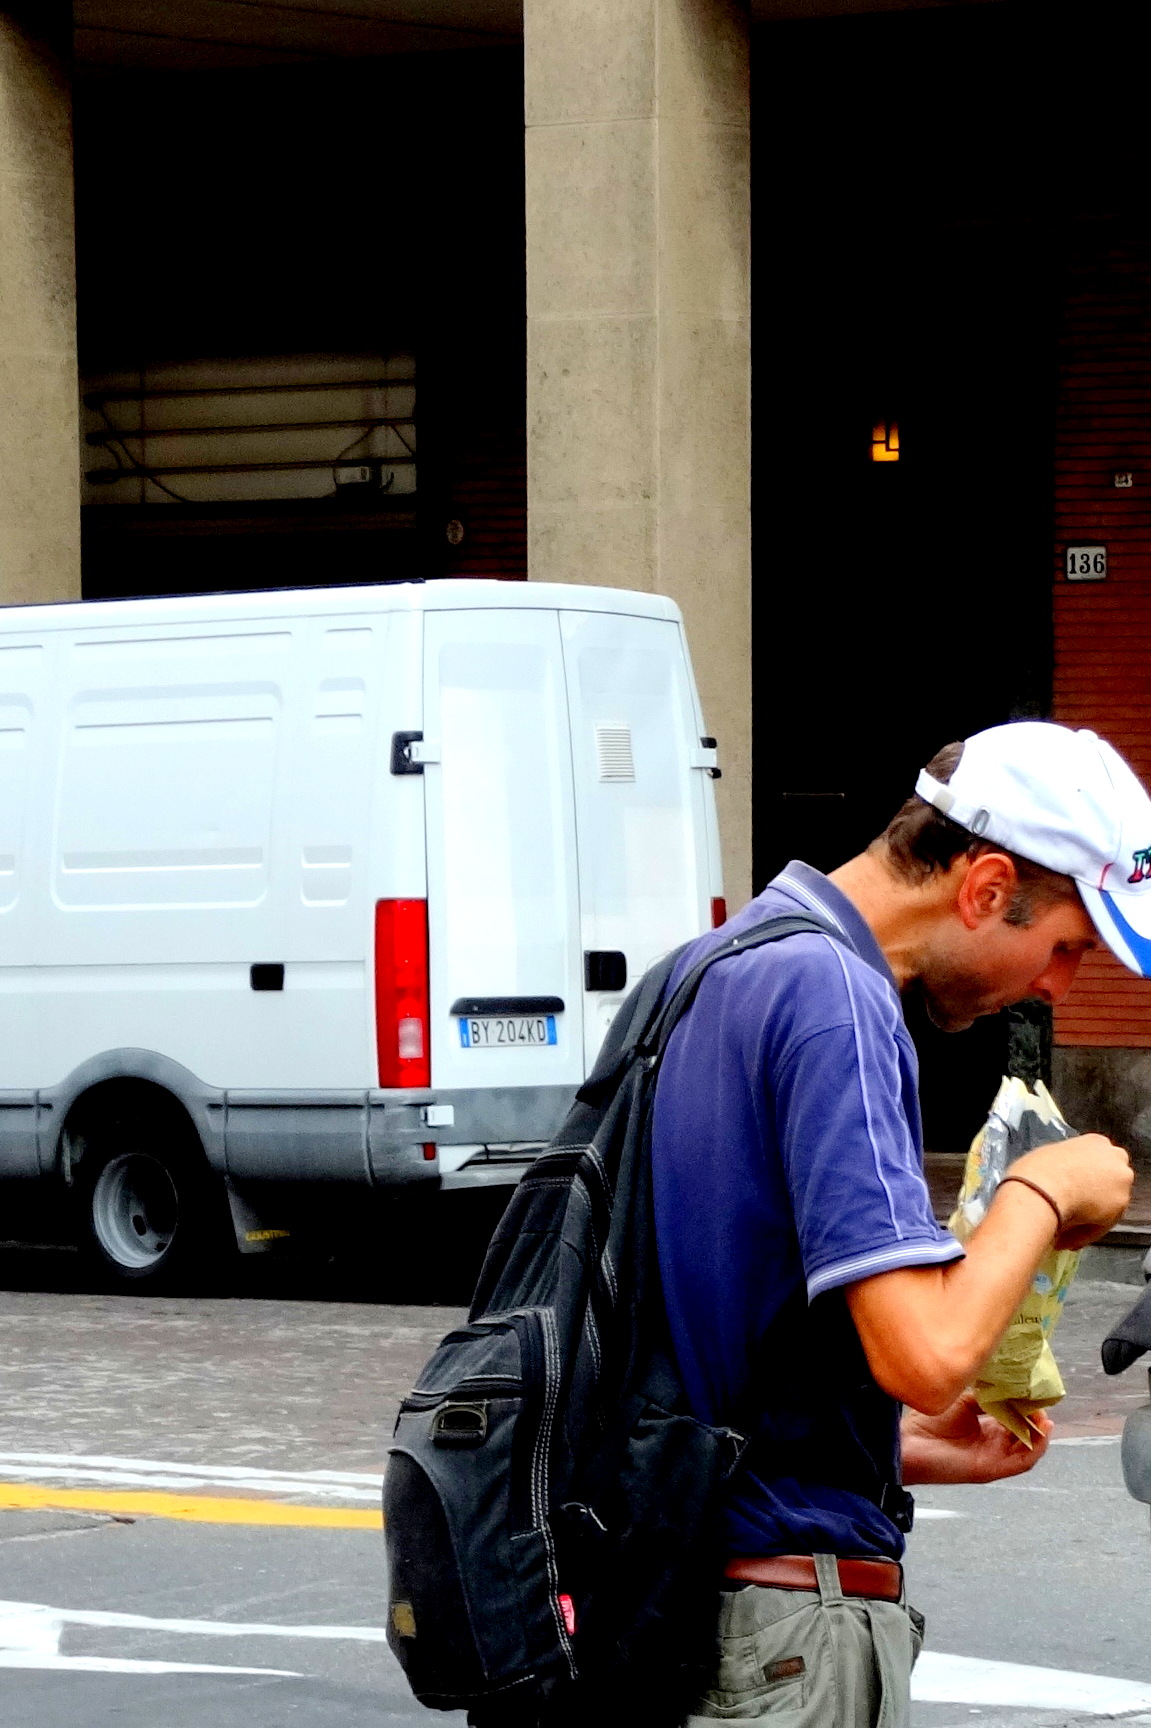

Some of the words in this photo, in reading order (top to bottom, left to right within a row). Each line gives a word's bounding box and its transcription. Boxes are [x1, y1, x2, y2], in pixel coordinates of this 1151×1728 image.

[1069, 553, 1105, 574] 136
[471, 1021, 490, 1044] BY
[496, 1019, 546, 1042] 204KD
